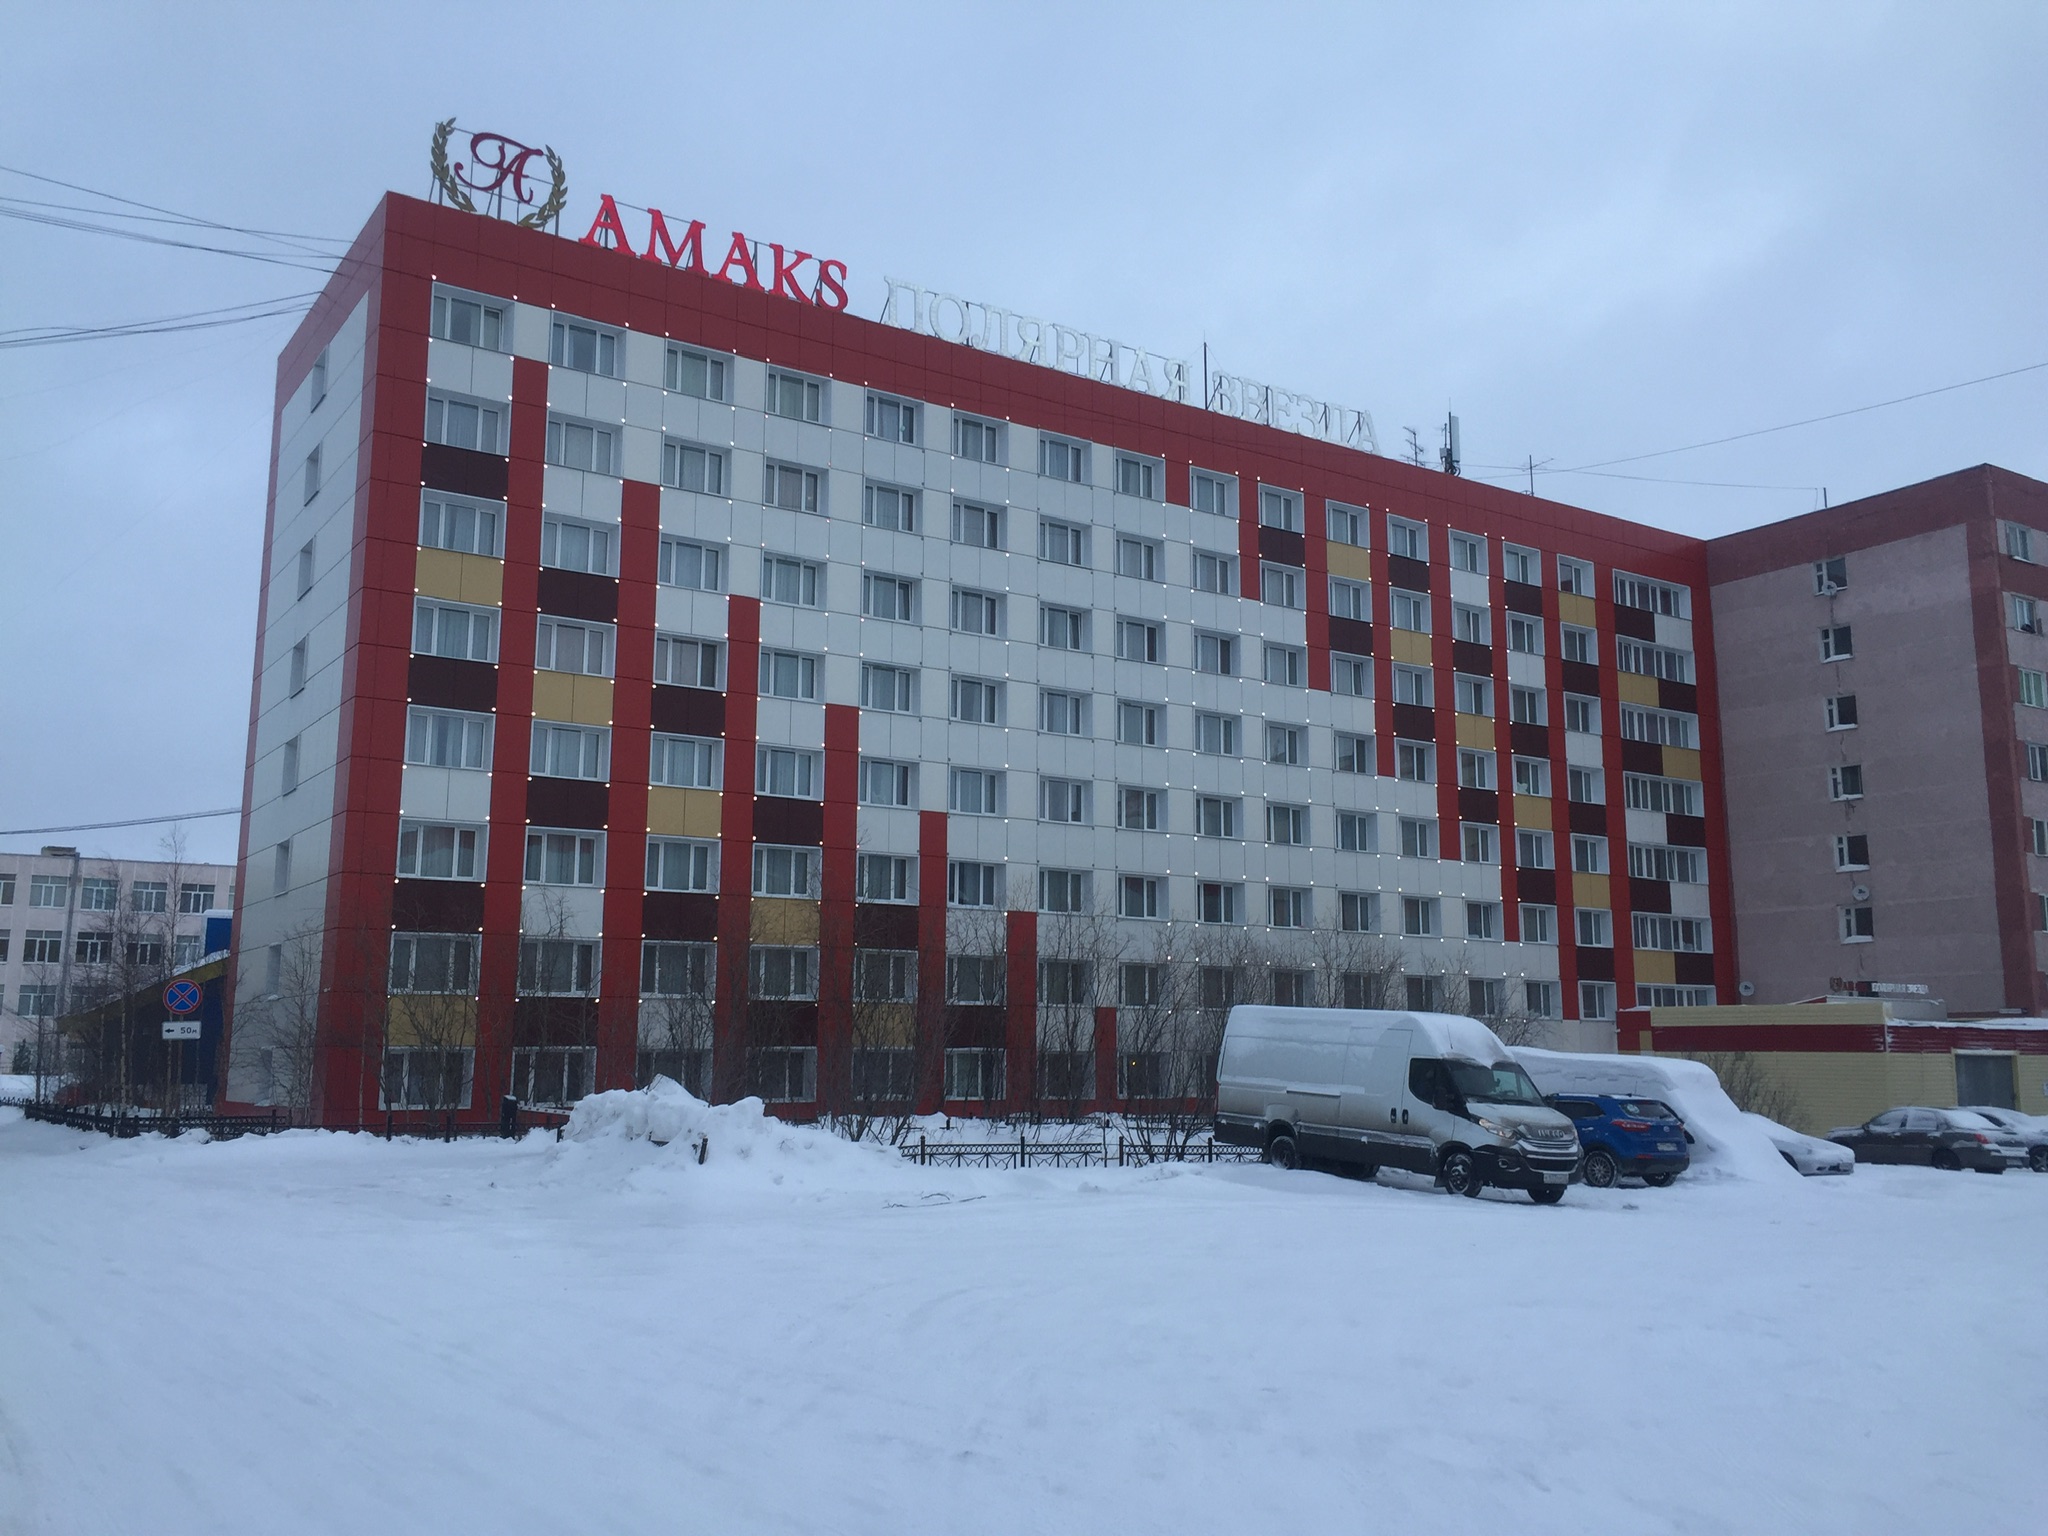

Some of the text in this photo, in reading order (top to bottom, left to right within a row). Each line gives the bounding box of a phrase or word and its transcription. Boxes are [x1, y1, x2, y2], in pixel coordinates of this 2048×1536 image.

[578, 194, 849, 313] AMAKS
[882, 275, 1383, 458] ПОЛЯРНАЯ ЗВЕЗДА
